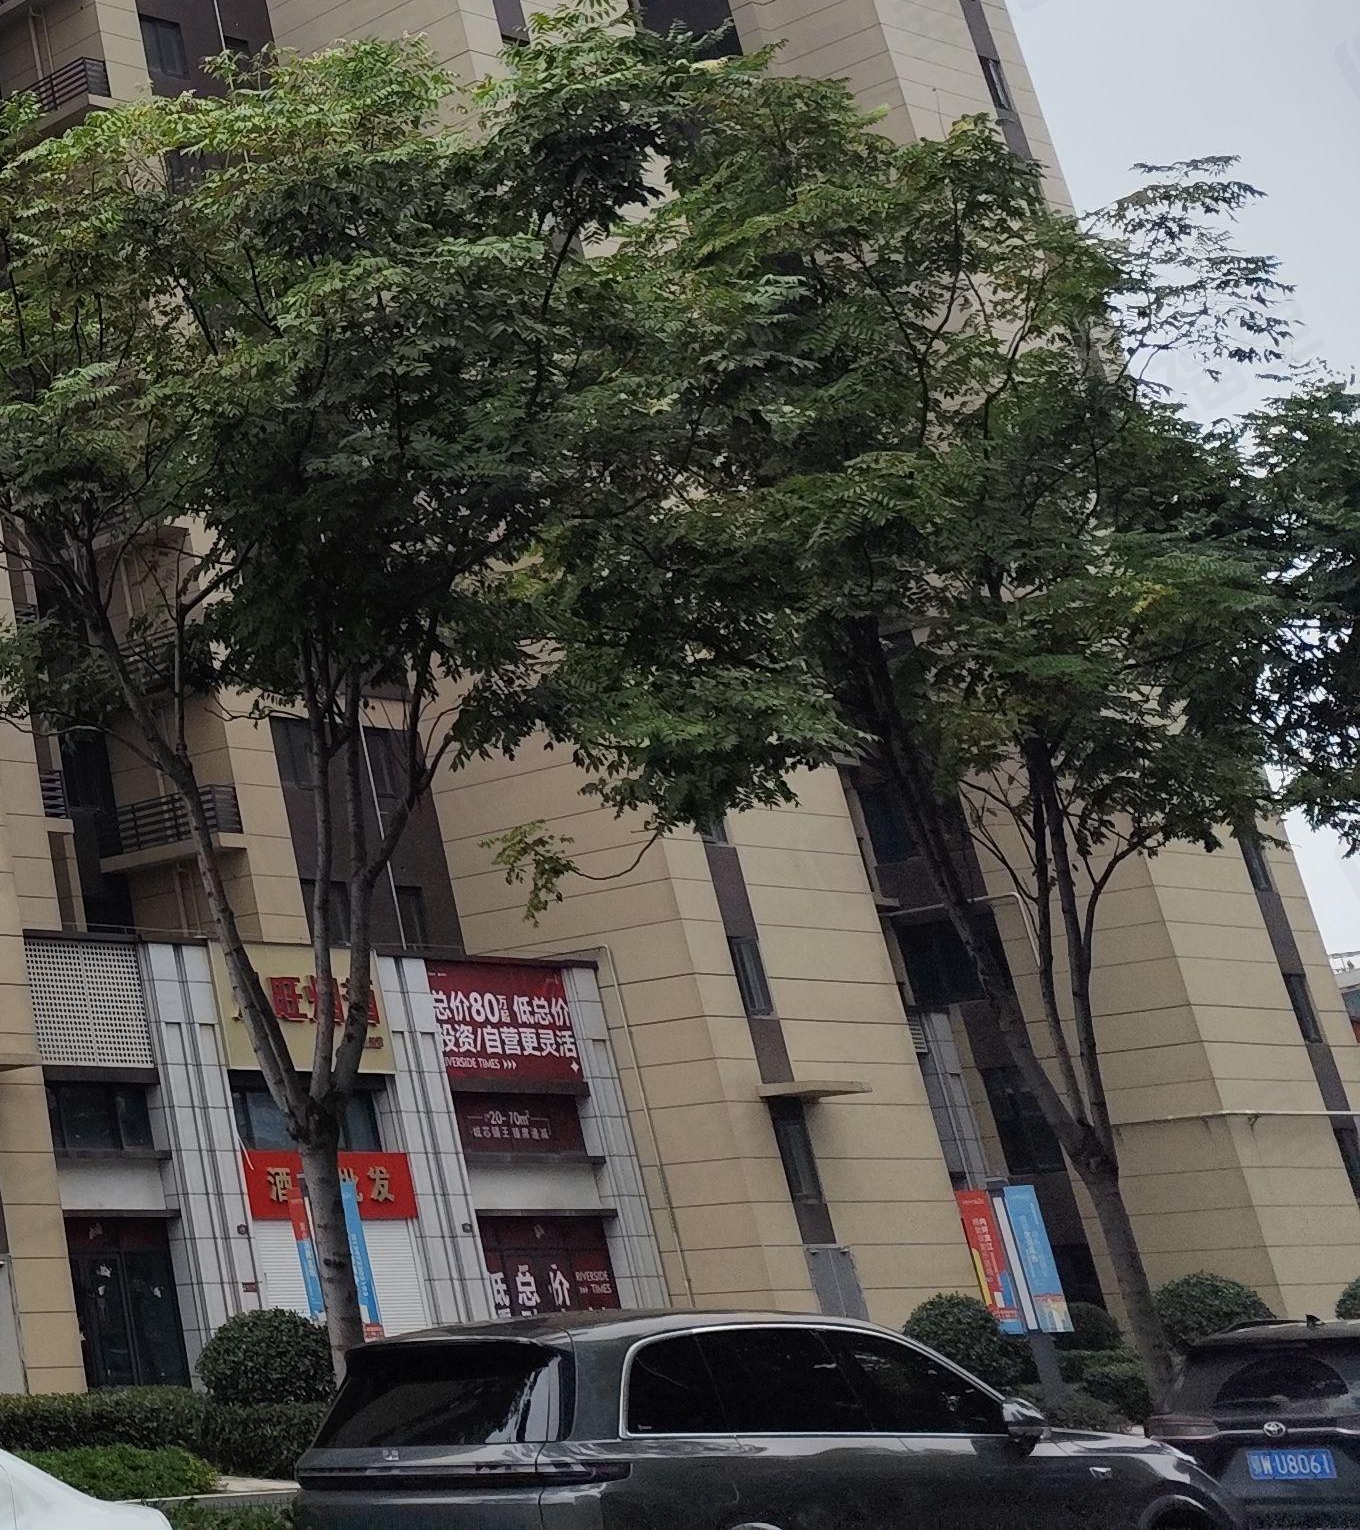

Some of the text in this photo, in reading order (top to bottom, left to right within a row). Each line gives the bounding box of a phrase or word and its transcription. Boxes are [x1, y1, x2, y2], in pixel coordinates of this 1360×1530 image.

[513, 995, 571, 1027] 低总价
[441, 1023, 578, 1058] 投资/自营更灵活
[478, 1058, 500, 1069] TIMES
[575, 1271, 609, 1281] RIVERSIDE
[591, 1284, 612, 1294] TIMES
